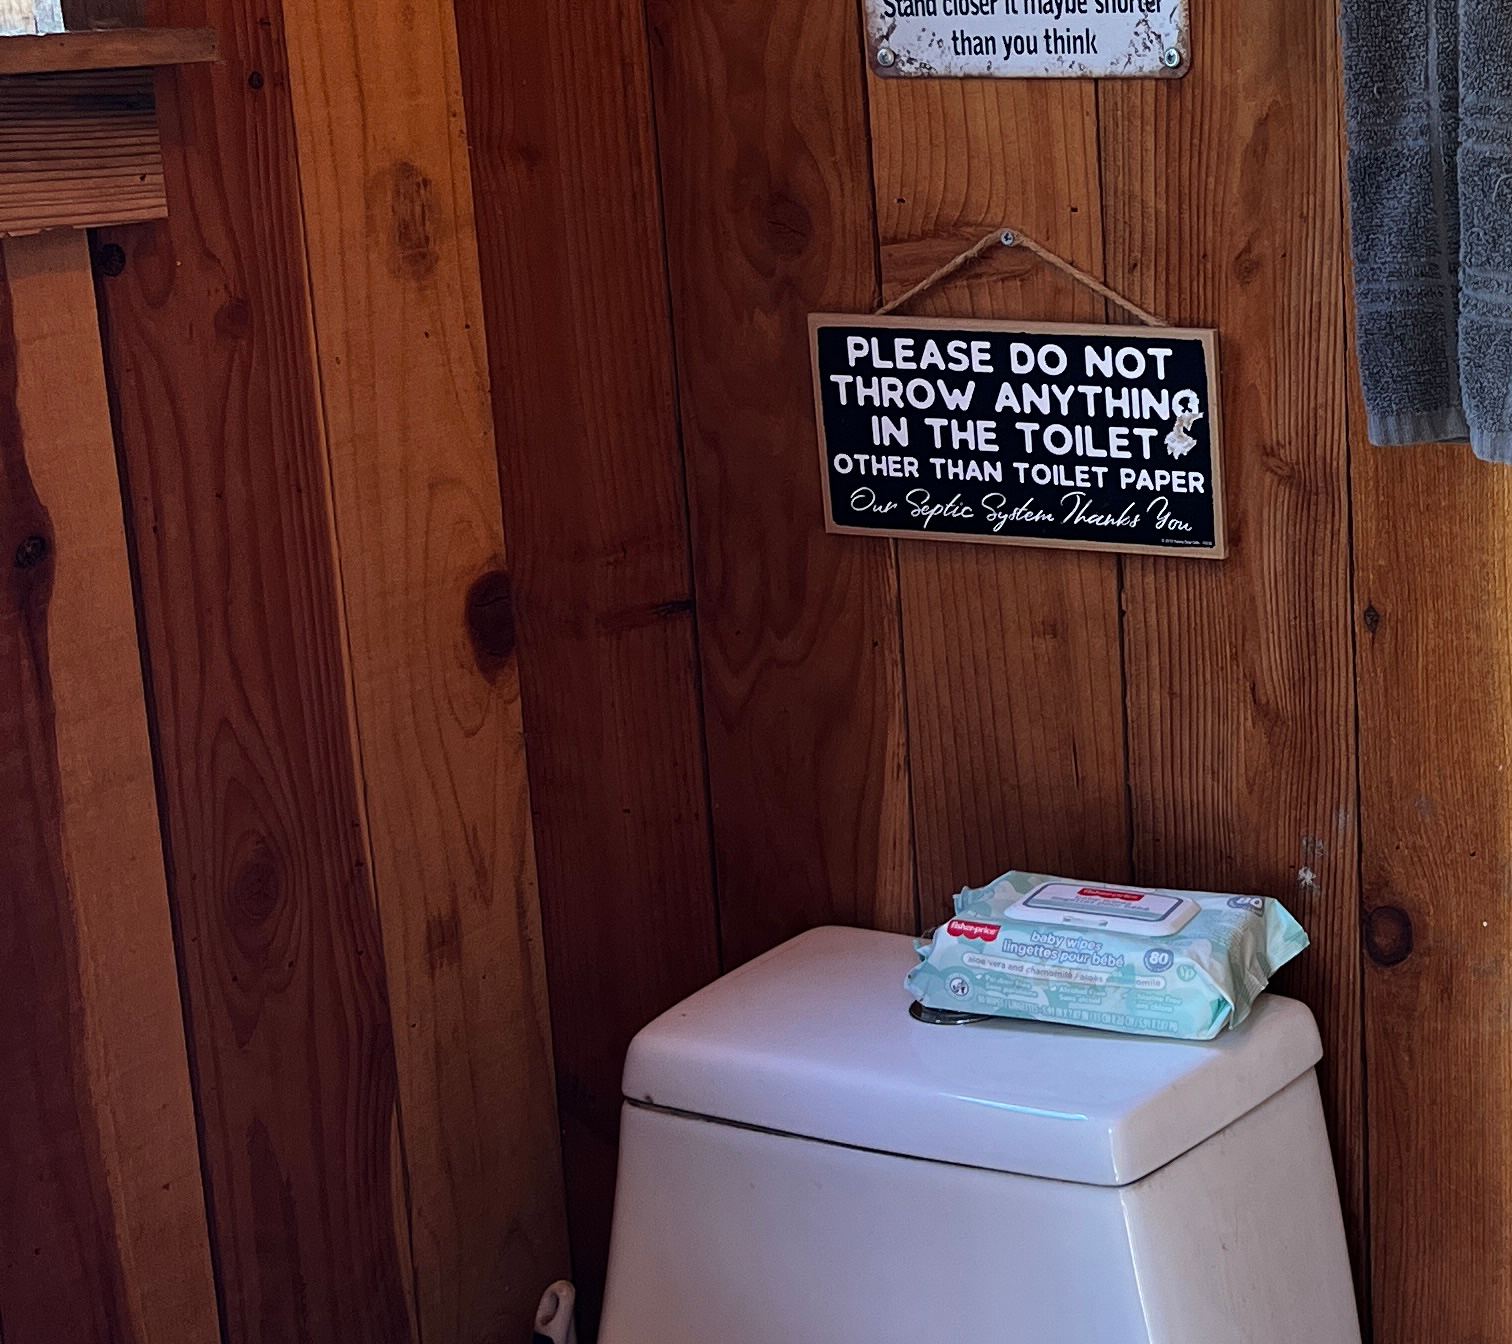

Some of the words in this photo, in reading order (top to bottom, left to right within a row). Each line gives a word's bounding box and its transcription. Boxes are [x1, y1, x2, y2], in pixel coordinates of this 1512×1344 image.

[951, 29, 996, 56] than
[1002, 33, 1038, 60] you
[1044, 28, 1097, 55] think
[846, 336, 994, 373] PLEASE
[1009, 342, 1067, 376] DO
[1085, 345, 1173, 381] NOT
[829, 374, 976, 412] THROW
[995, 381, 1200, 421] ANYTHING
[871, 415, 908, 447] IN
[924, 418, 999, 452] THE
[1015, 421, 1158, 460] TOILET
[833, 453, 920, 479] OTHER
[930, 457, 1003, 484] THAN
[1012, 461, 1108, 489] TOILET
[1120, 468, 1205, 494] PAPER
[850, 487, 899, 515] Our
[905, 489, 975, 529] Septic
[981, 492, 1055, 533] System
[1060, 491, 1141, 529] Thanks
[1147, 497, 1193, 533] You
[1002, 938, 1058, 961] lingettes
[1059, 949, 1092, 964] pour
[1091, 952, 1125, 968] bébé
[1031, 930, 1063, 949] baby
[1065, 936, 1103, 952] wipes
[1148, 950, 1169, 965] 80
[966, 955, 987, 966] aloe
[987, 958, 1006, 969] vera
[1007, 961, 1025, 972] and
